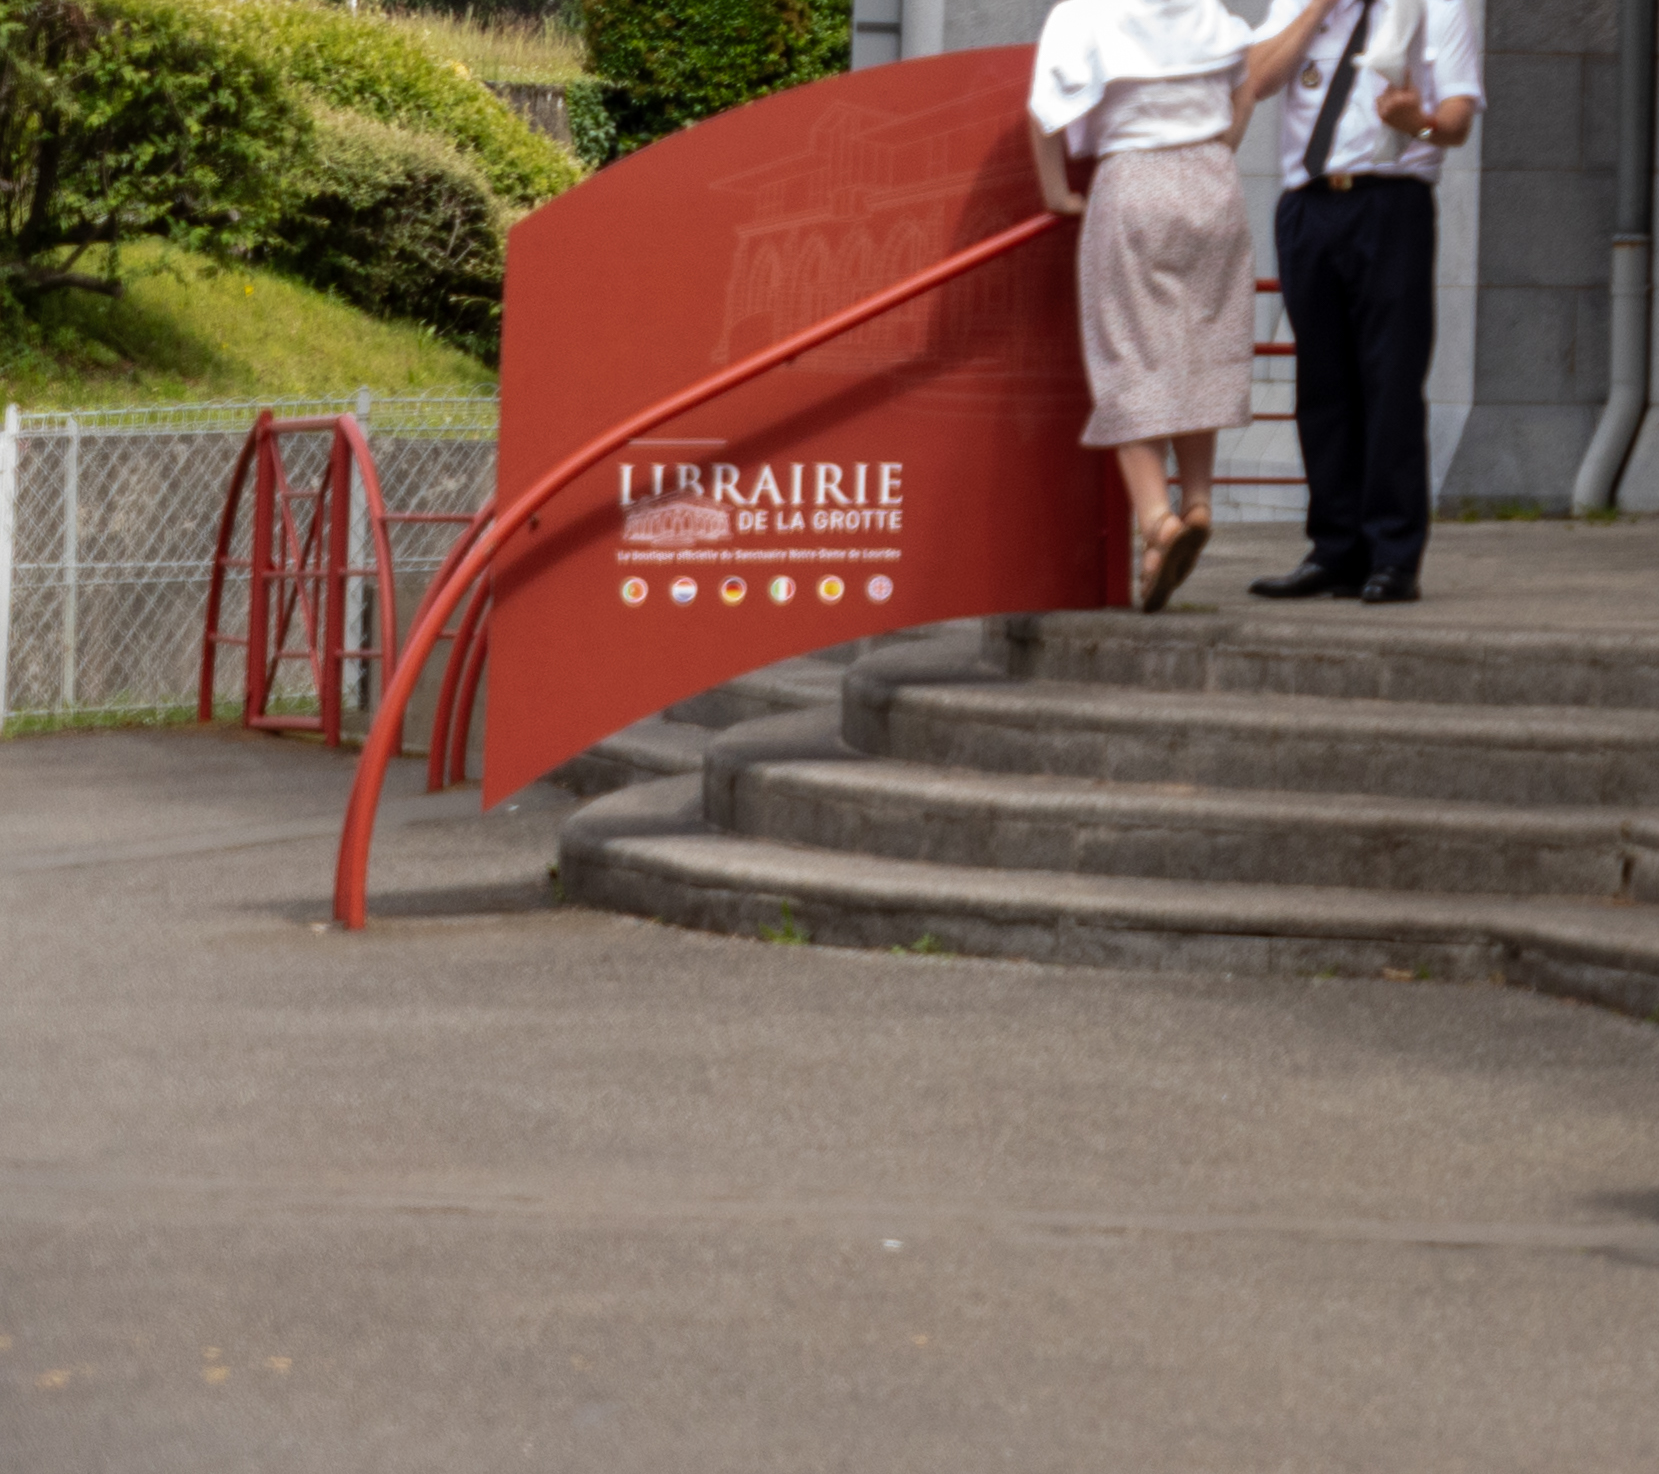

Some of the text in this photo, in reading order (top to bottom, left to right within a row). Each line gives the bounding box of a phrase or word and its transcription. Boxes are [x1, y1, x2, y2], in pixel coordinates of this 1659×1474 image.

[618, 462, 904, 506] LIBRAIRIE
[738, 508, 904, 533] DE LA GROTTE
